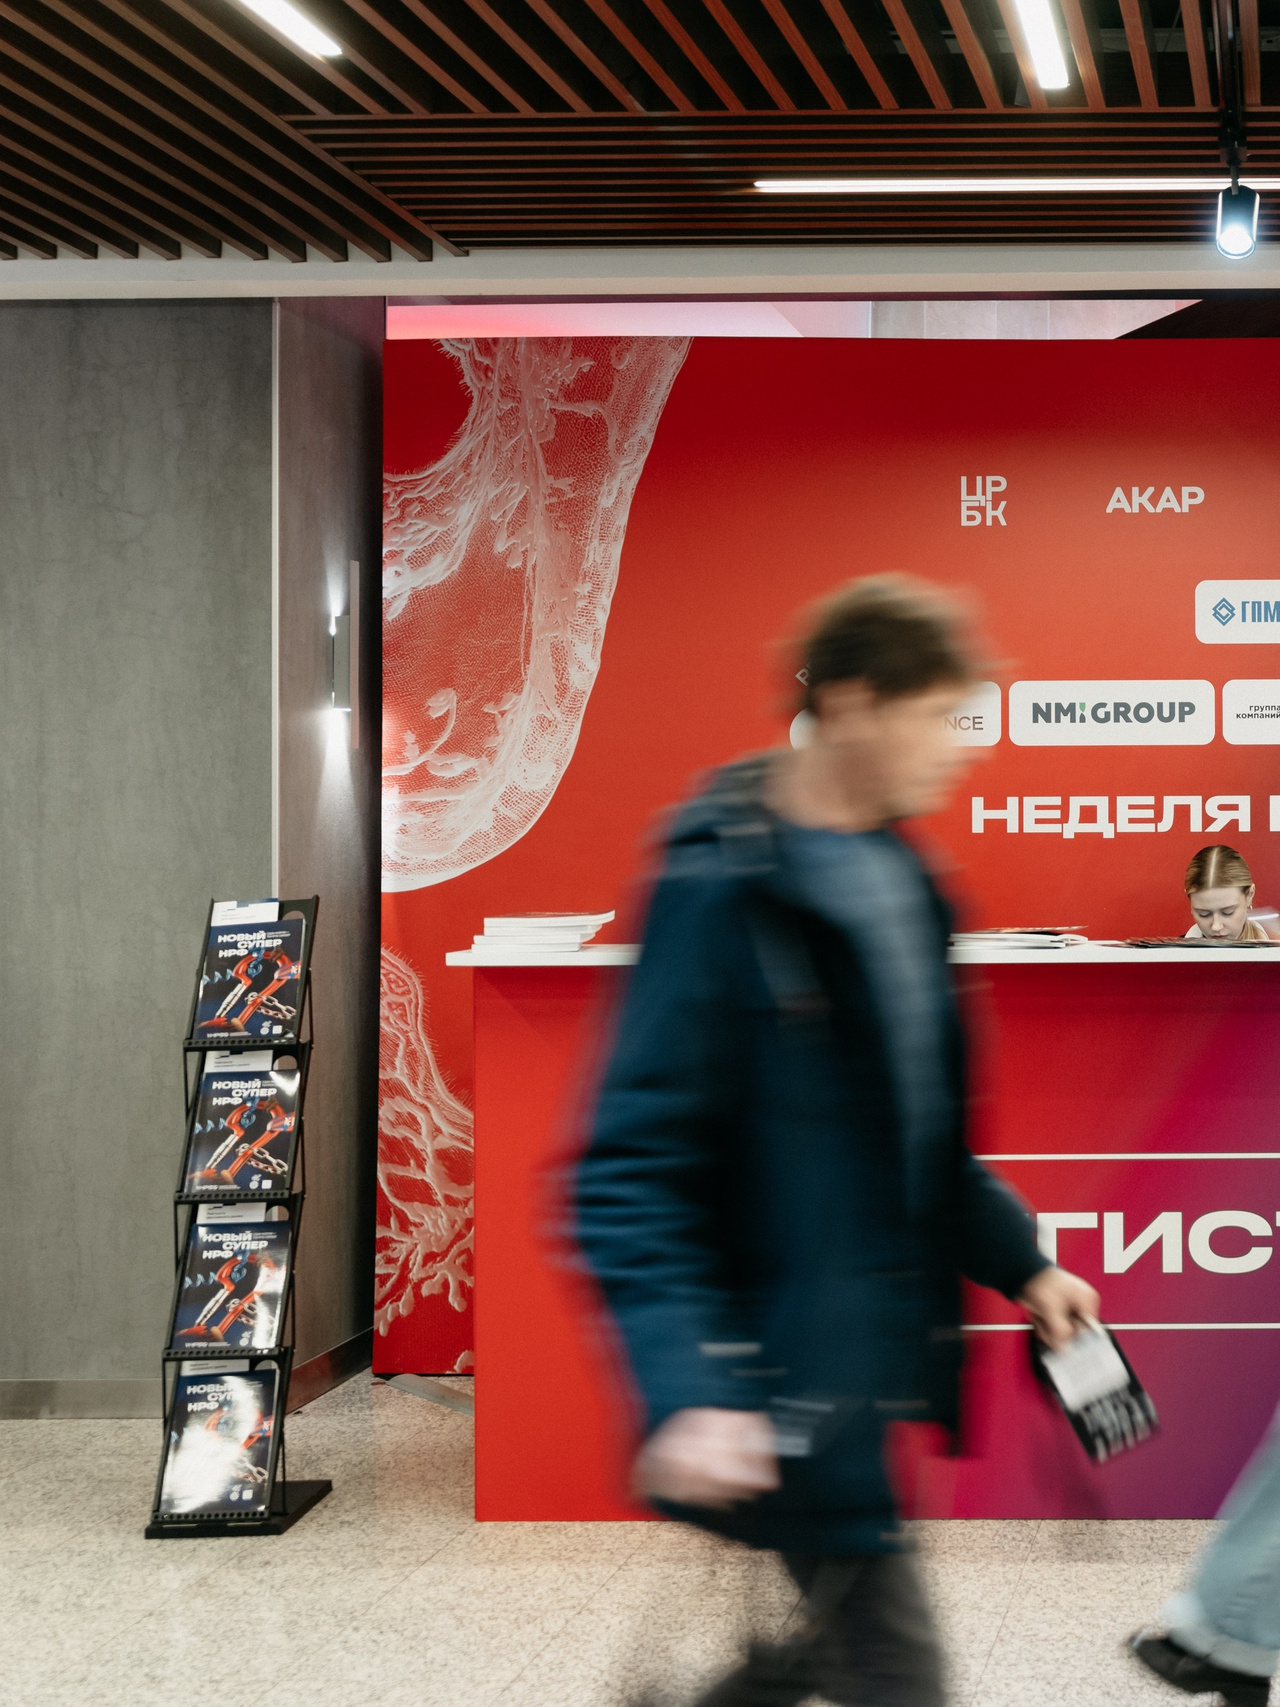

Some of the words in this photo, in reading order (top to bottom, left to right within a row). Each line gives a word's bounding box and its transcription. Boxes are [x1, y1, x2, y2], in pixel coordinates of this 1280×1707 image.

[1105, 486, 1205, 513] АКАР
[1241, 600, 1280, 623] ГПМ
[943, 716, 984, 731] NCE
[971, 795, 1251, 839] НЕДЕЛЯ
[217, 930, 267, 944] НОВЫЙ
[237, 938, 283, 949] СУПЕР
[218, 948, 249, 958] НРФ
[212, 1078, 262, 1090] НОВЫЙ
[231, 1087, 278, 1097] СУПЕР
[212, 1096, 243, 1106] НРФ
[202, 1230, 253, 1243] НОВЫЙ
[222, 1240, 269, 1251] СУПЕР
[202, 1250, 234, 1259] НРФ
[186, 1382, 237, 1395] НОВЫ
[207, 1390, 254, 1402] СУП
